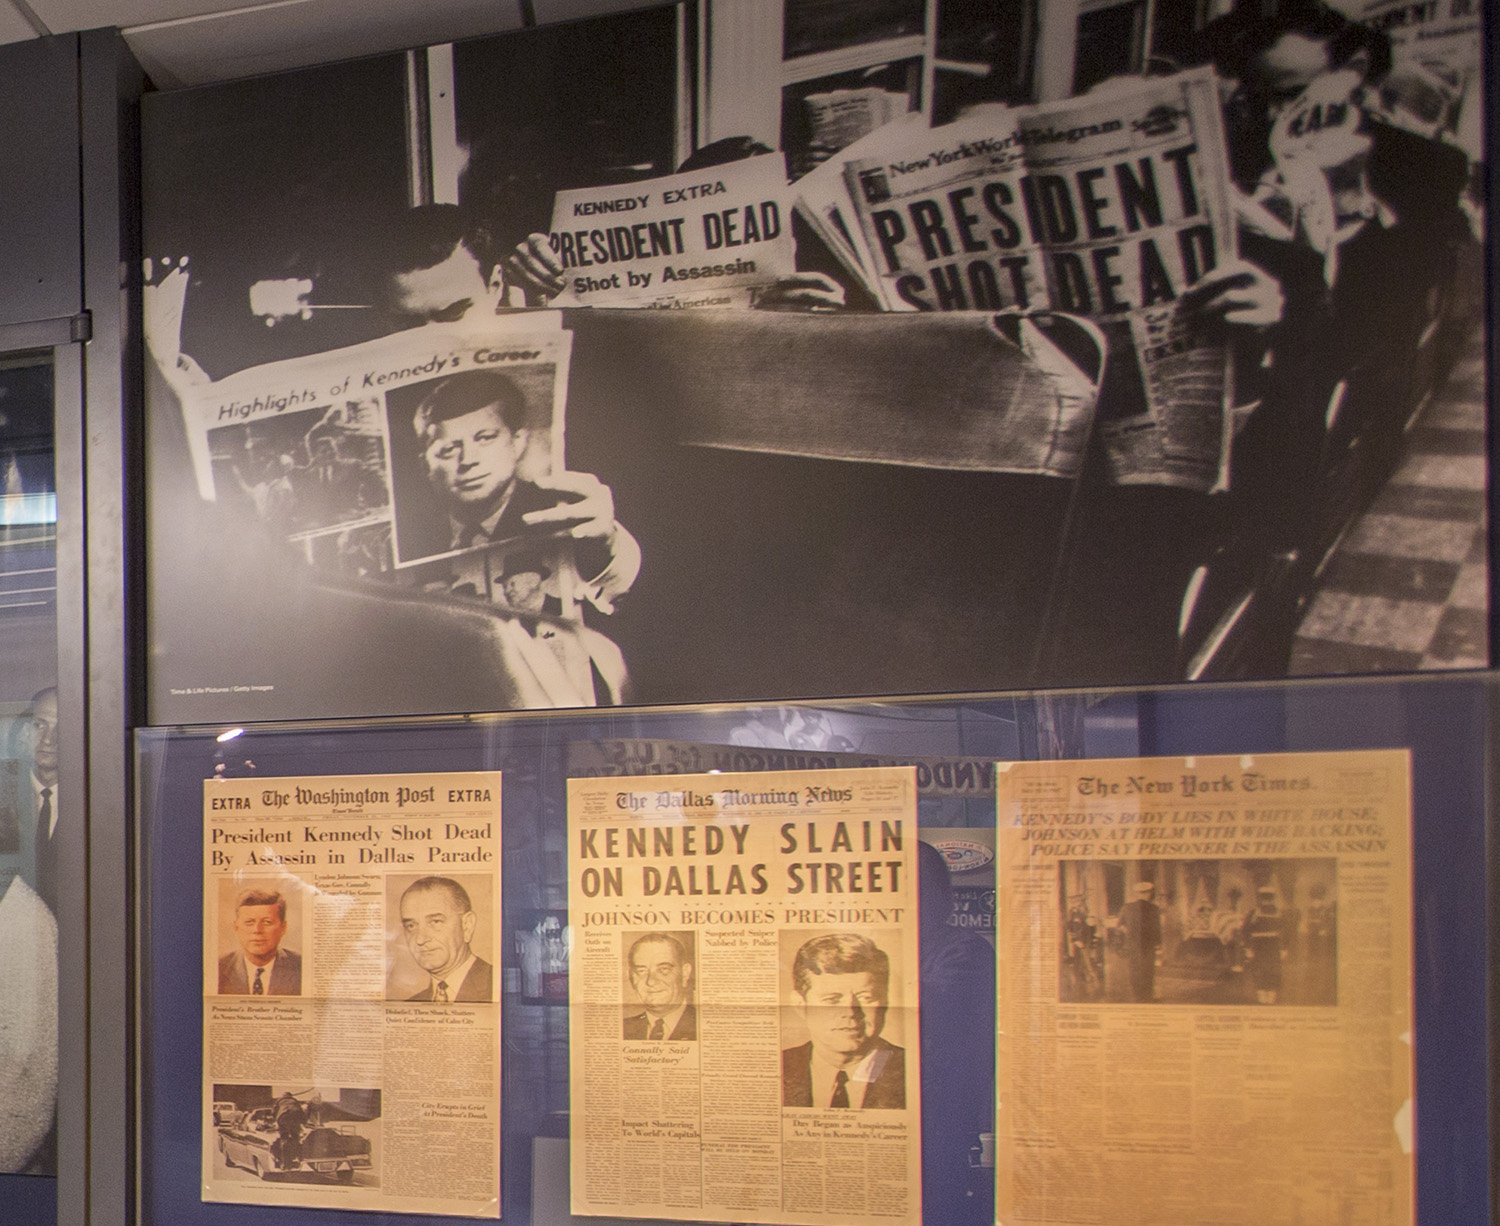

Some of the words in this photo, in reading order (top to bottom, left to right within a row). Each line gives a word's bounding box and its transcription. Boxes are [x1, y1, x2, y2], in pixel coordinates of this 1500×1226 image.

[574, 196, 650, 216] KENNEDY
[663, 181, 727, 204] EXTRA
[871, 145, 1204, 273] PRESIDENT
[703, 200, 781, 250] DEAD
[574, 274, 620, 293] Shot
[628, 272, 652, 288] by
[662, 259, 756, 282] Assassin
[895, 256, 1030, 311] SHOT
[1053, 224, 1217, 315] DEAD
[217, 388, 318, 422] Highlights
[329, 376, 351, 396] of
[362, 352, 460, 389] Kennedy's
[474, 347, 542, 365] Career
[212, 797, 251, 810] EXTRA
[262, 791, 289, 809] The
[295, 786, 389, 807] Washington
[396, 786, 435, 807] Post
[448, 789, 491, 802] EXTRA
[616, 792, 648, 811] The
[656, 792, 714, 809] Dallas
[722, 788, 798, 809] Morning
[805, 786, 852, 803] News
[1077, 777, 1120, 798] The
[1127, 776, 1175, 795] New
[1181, 775, 1234, 798] York
[212, 828, 292, 844] President
[304, 825, 383, 846] Kennedy
[392, 824, 432, 840] Shot
[446, 824, 491, 840] Dead
[580, 824, 750, 859] KENNEDY
[780, 820, 903, 854] SLAIN
[212, 850, 233, 870] By
[246, 850, 316, 865] Assassin
[328, 850, 345, 864] in
[359, 848, 415, 864] Dallas
[428, 847, 492, 862] Parade
[581, 866, 624, 897] ON
[643, 863, 769, 896] DALLAS
[788, 861, 903, 894] STREET
[581, 910, 671, 928] JOHNSON
[681, 909, 775, 924] BECOMES
[785, 908, 904, 924] PRESIDENT
